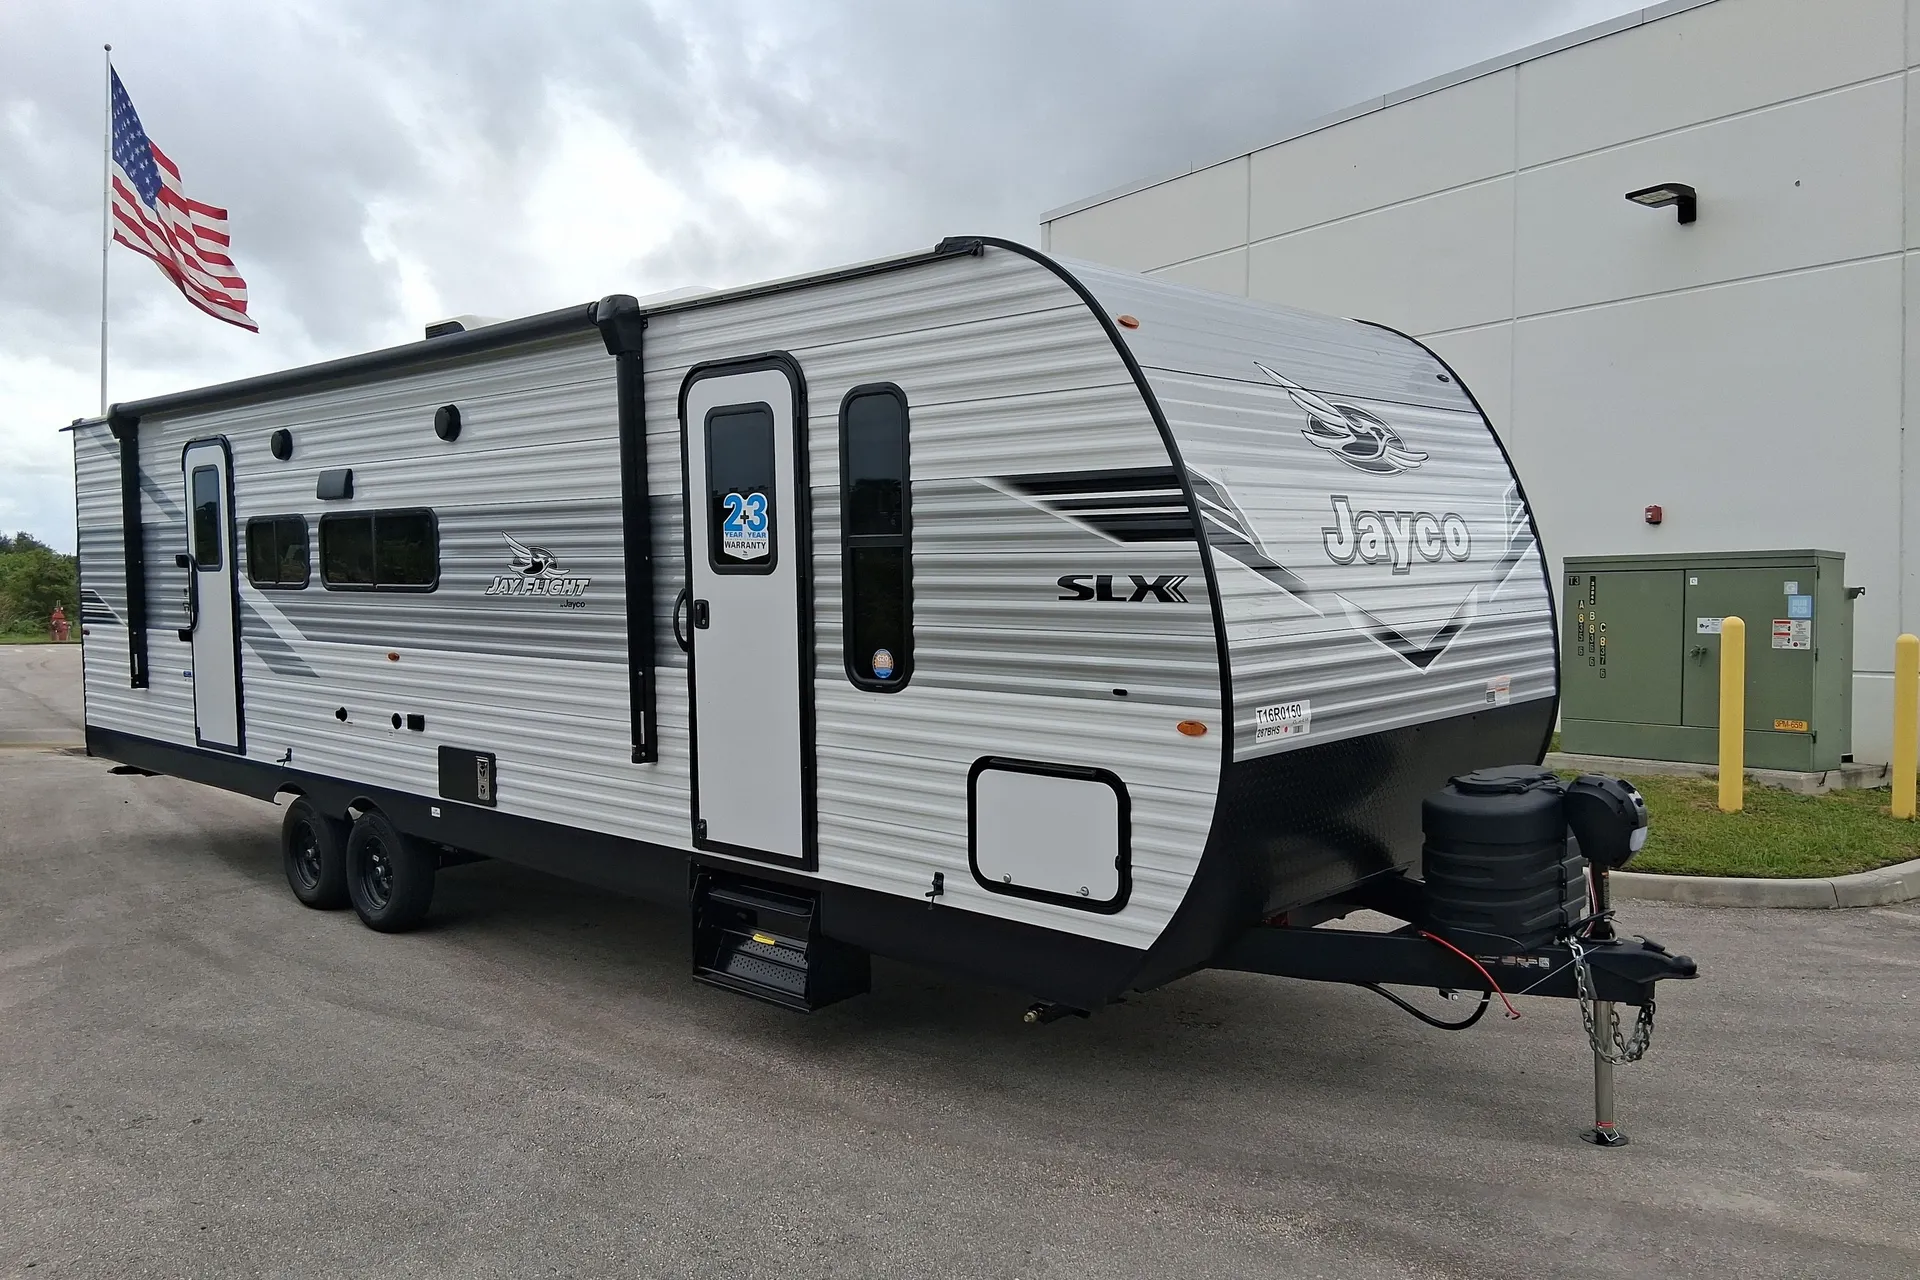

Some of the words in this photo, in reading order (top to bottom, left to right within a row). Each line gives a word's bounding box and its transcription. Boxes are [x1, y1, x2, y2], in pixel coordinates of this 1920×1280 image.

[1321, 495, 1471, 575] Jayco
[725, 541, 767, 549] WARRANTY
[485, 576, 520, 596] JAY
[520, 577, 591, 596] FLIGHT
[1569, 577, 1580, 586] T3
[1056, 574, 1189, 603] SLX
[563, 600, 586, 609] Jayco
[1578, 599, 1585, 609] A
[1589, 611, 1595, 621] B
[1600, 622, 1606, 632] C
[1257, 704, 1302, 724] T16R0150
